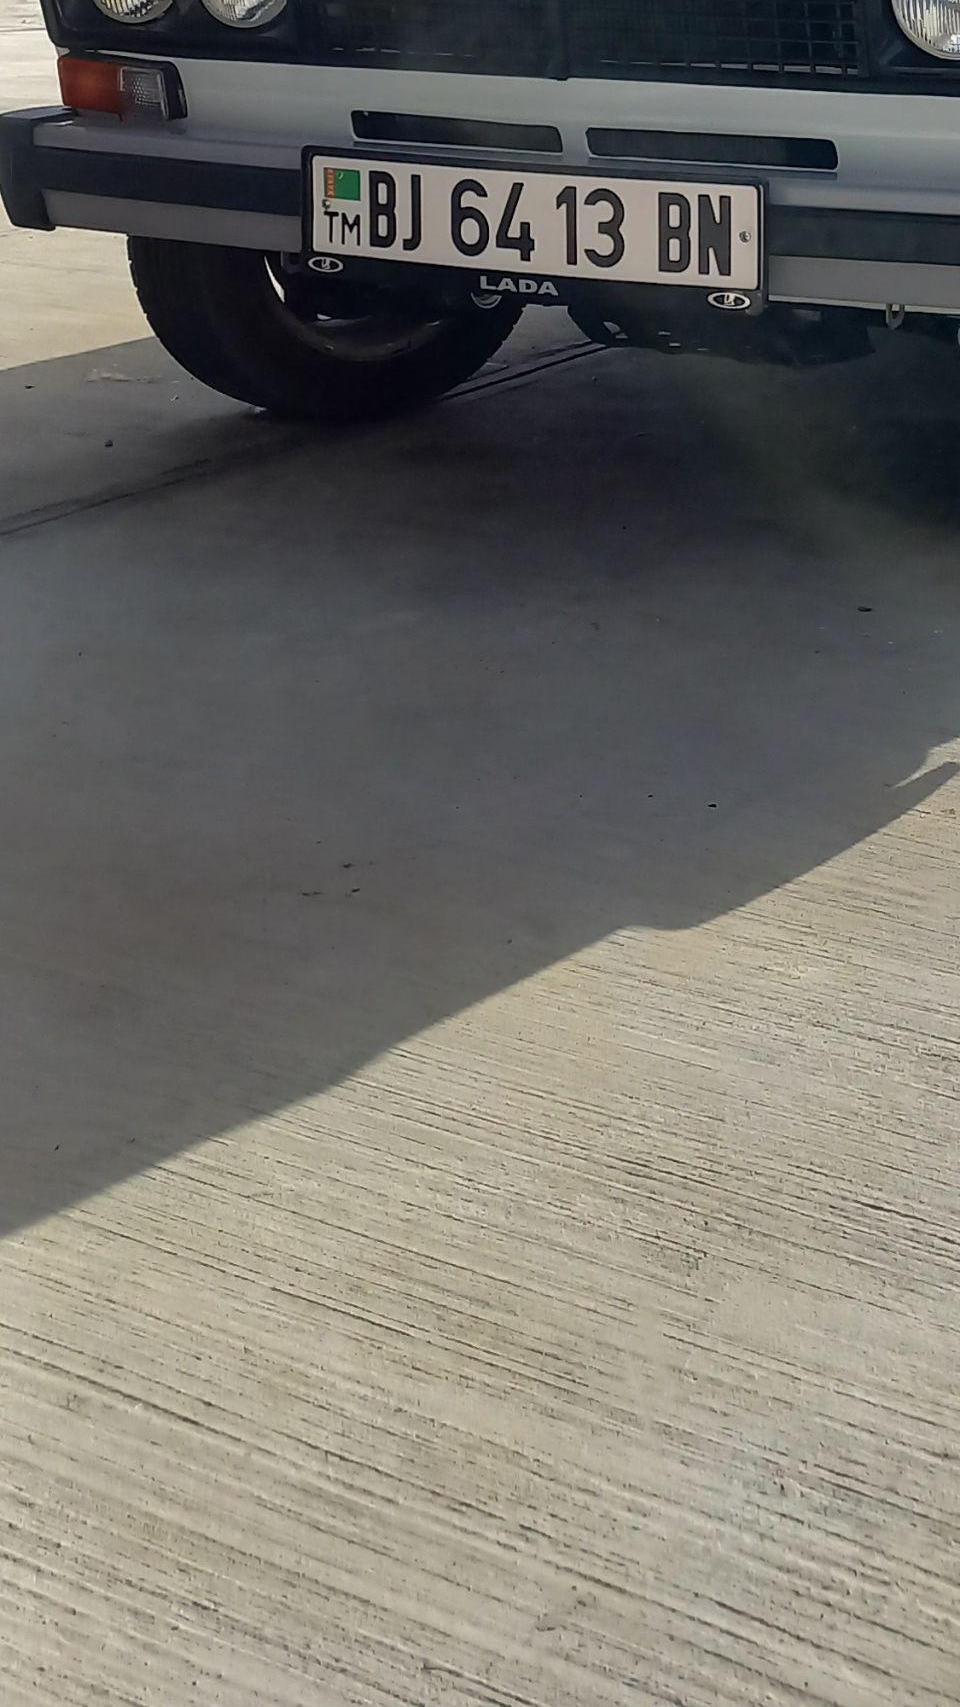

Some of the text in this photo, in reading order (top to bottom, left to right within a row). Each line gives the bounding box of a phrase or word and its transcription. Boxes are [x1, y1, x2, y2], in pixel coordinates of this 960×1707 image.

[323, 211, 361, 246] TM
[369, 171, 422, 250] BJ
[657, 192, 732, 276] BN
[479, 275, 559, 296] LADA
